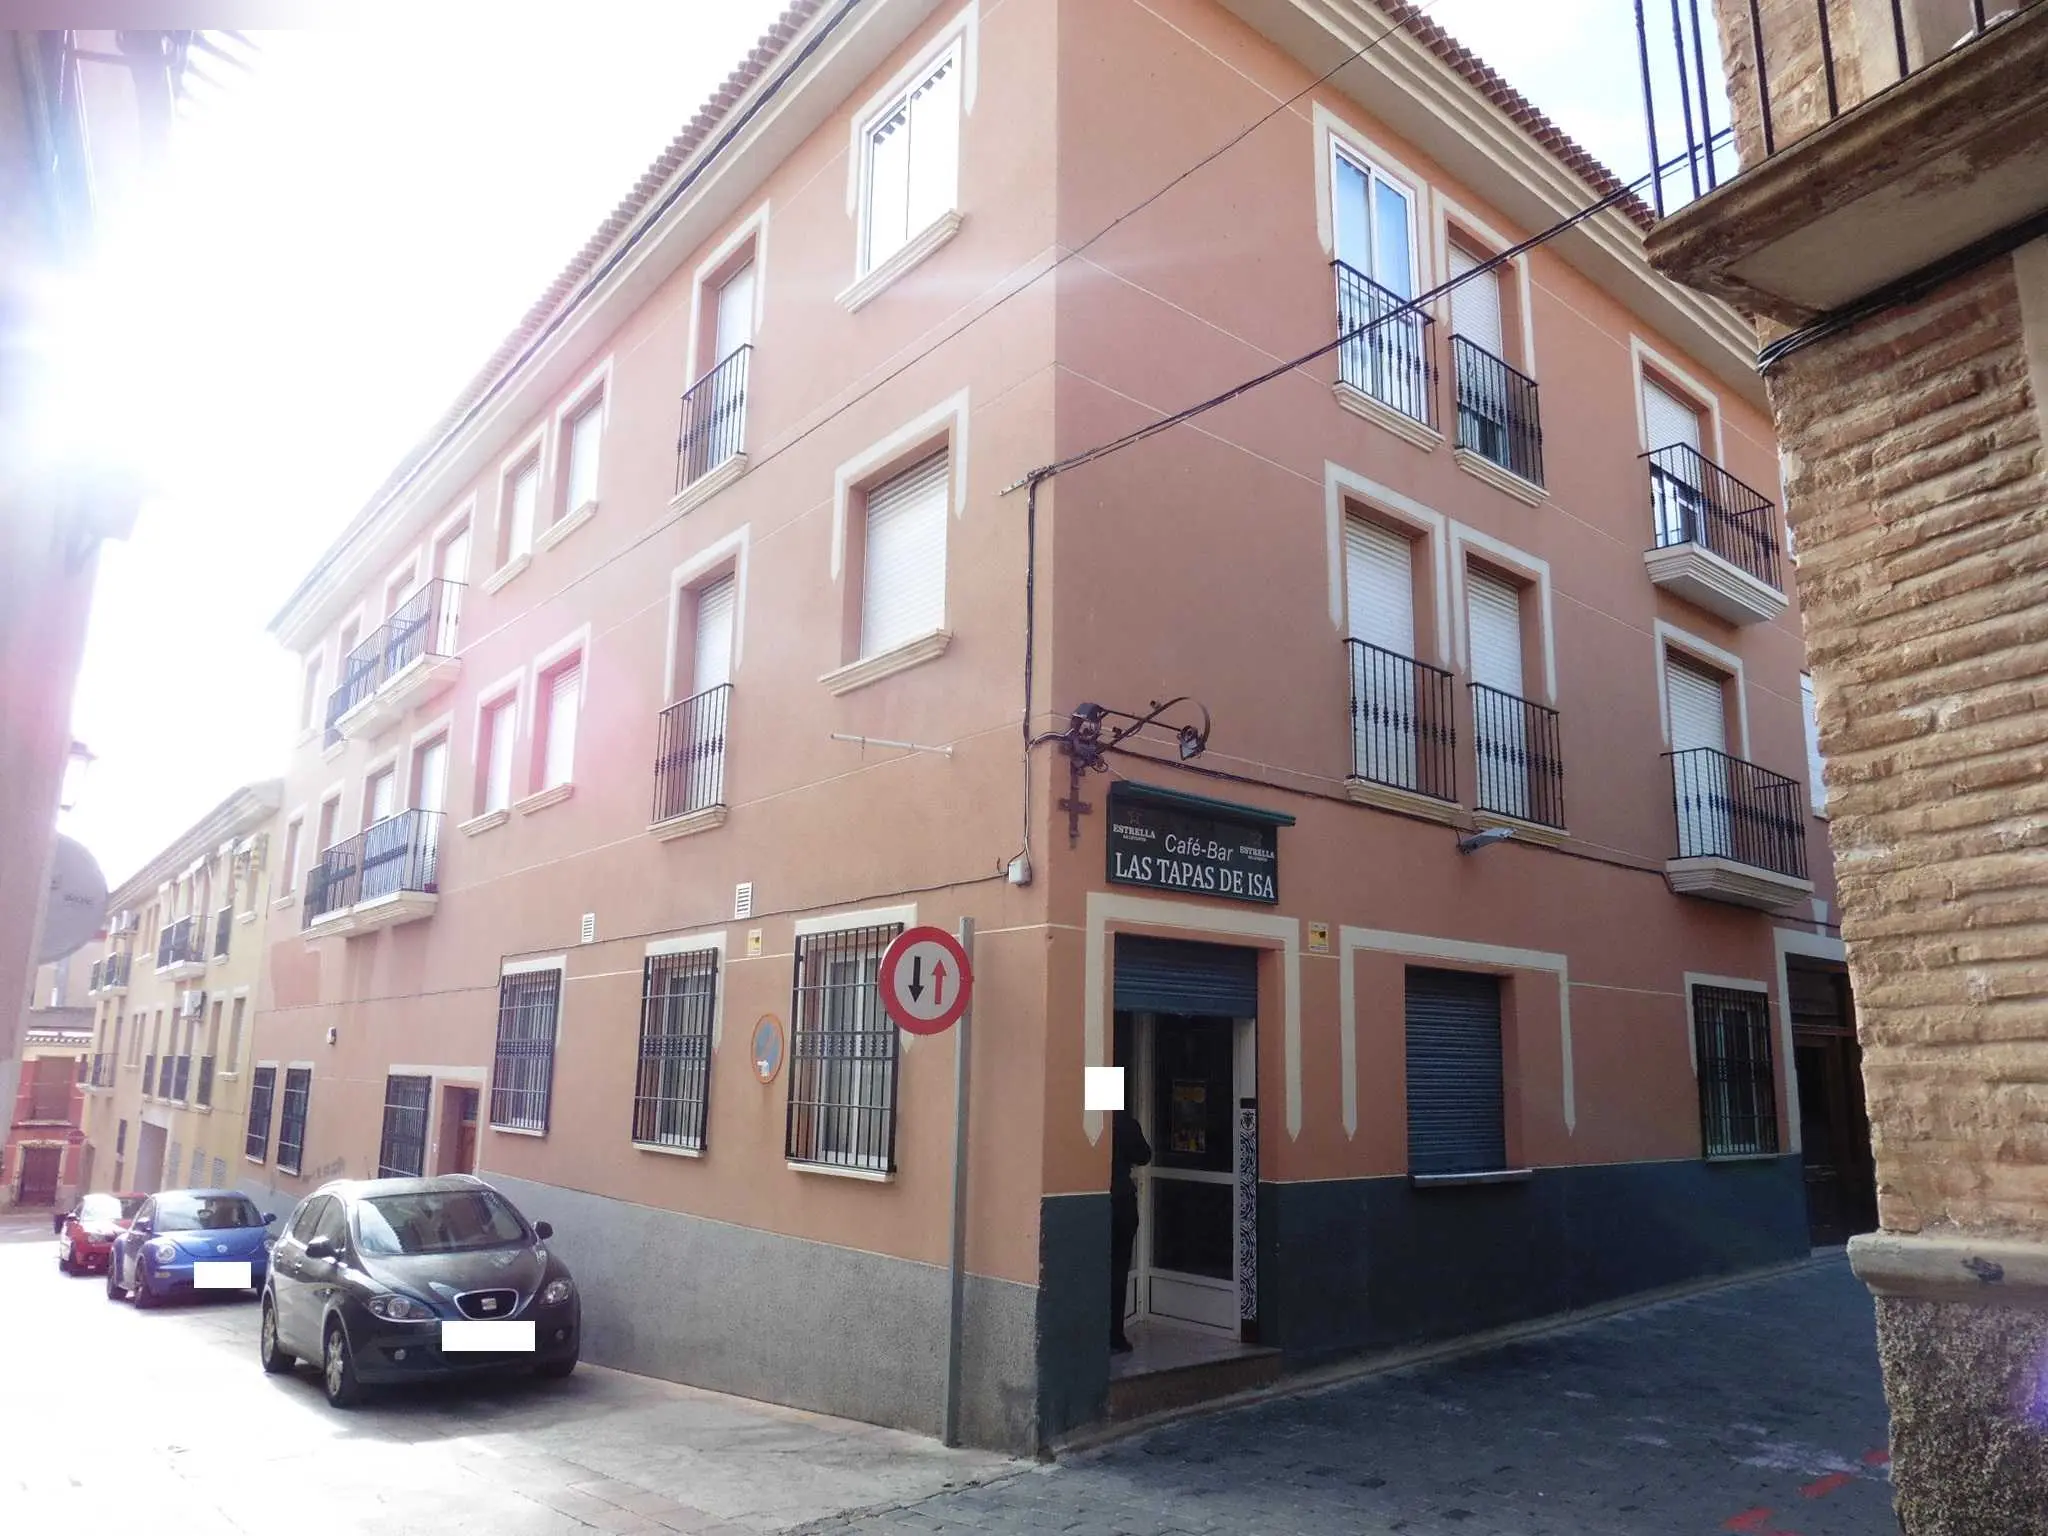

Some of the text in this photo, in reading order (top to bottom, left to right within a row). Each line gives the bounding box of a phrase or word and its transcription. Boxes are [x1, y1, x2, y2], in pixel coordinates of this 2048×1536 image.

[1112, 823, 1156, 839] ESTRELLA
[1165, 833, 1234, 861] Café-Bar
[1115, 851, 1275, 899] LAS TAPAS DE ISA
